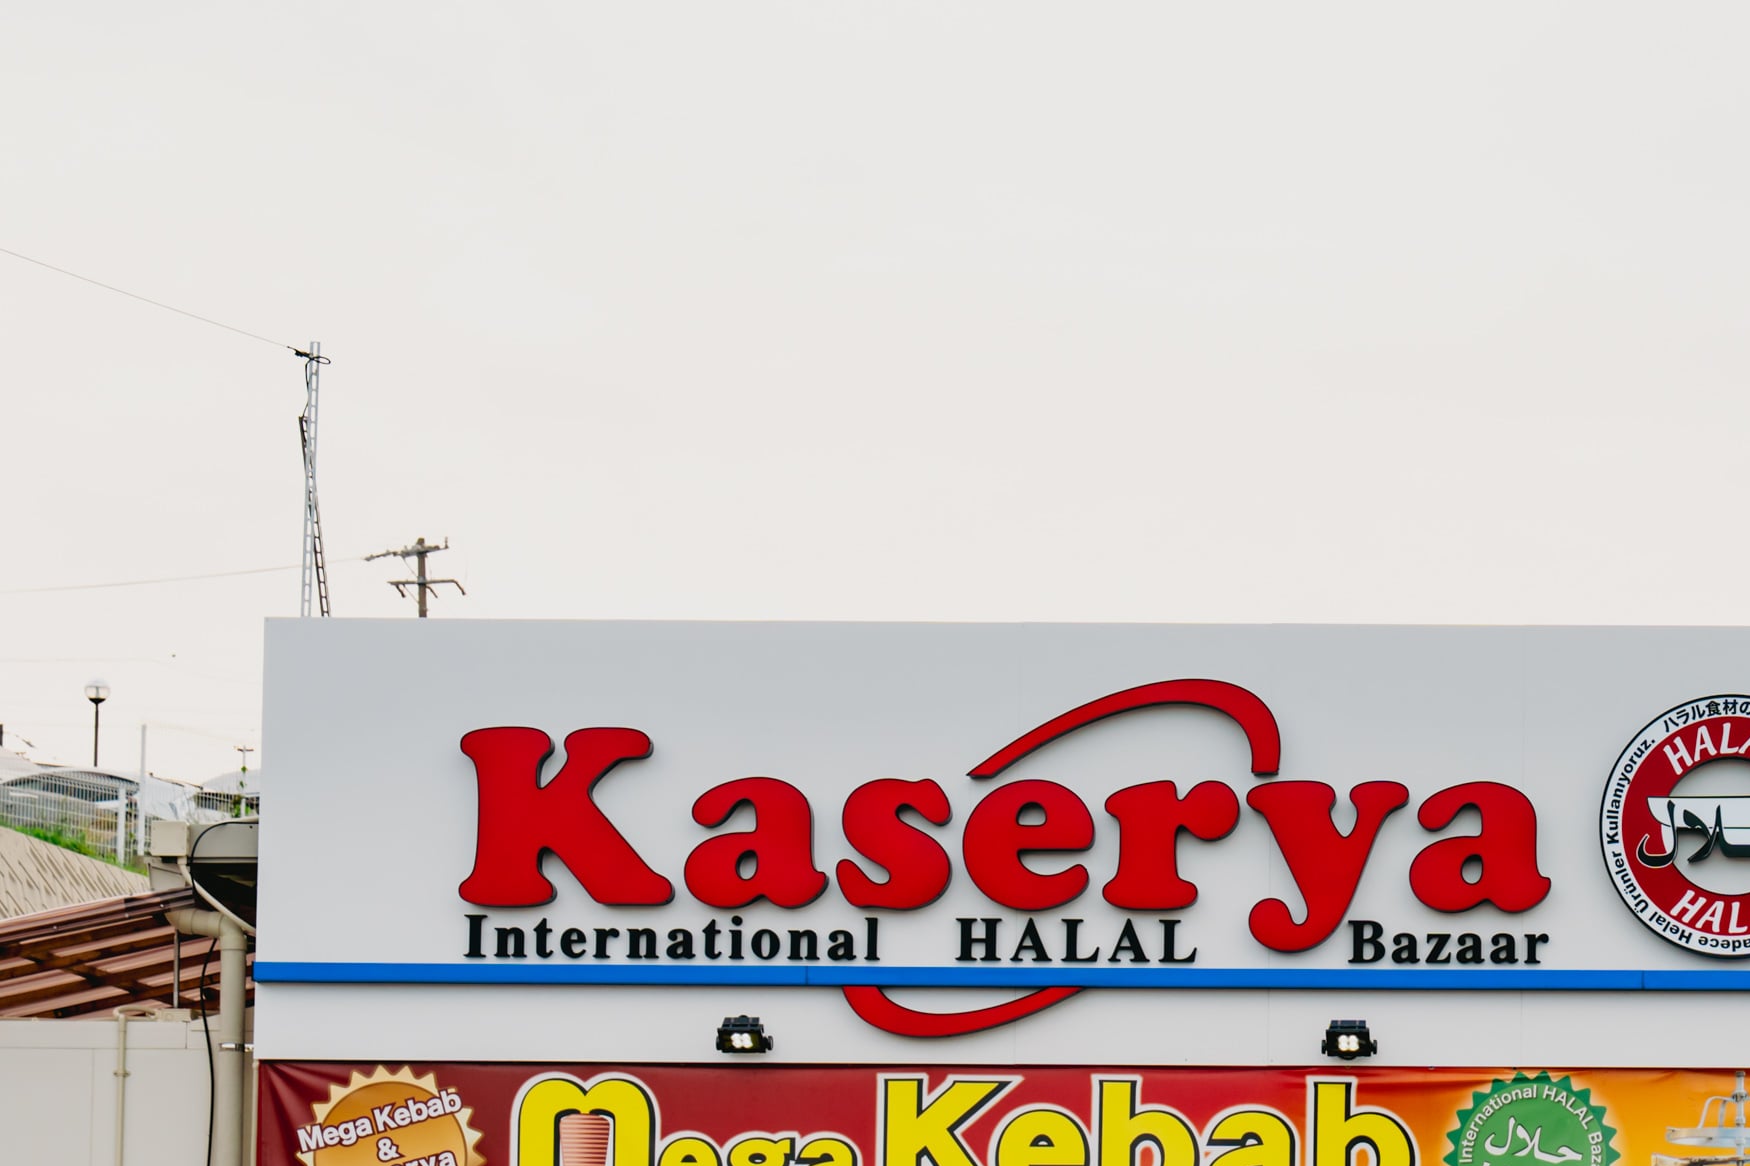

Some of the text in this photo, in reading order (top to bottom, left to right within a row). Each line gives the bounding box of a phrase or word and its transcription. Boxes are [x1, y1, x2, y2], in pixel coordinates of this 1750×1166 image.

[458, 726, 1552, 953] Kaserya
[1612, 851, 1649, 913] Ürünler
[463, 913, 1550, 965] International HALAL Bazaar
[1649, 911, 1693, 945] Helal
[297, 1089, 463, 1153] Mega Kebab
[377, 1137, 404, 1162] &
[1459, 1085, 1538, 1165] International
[1543, 1086, 1593, 1130] HALAL
[1484, 1116, 1583, 1164] حلال
